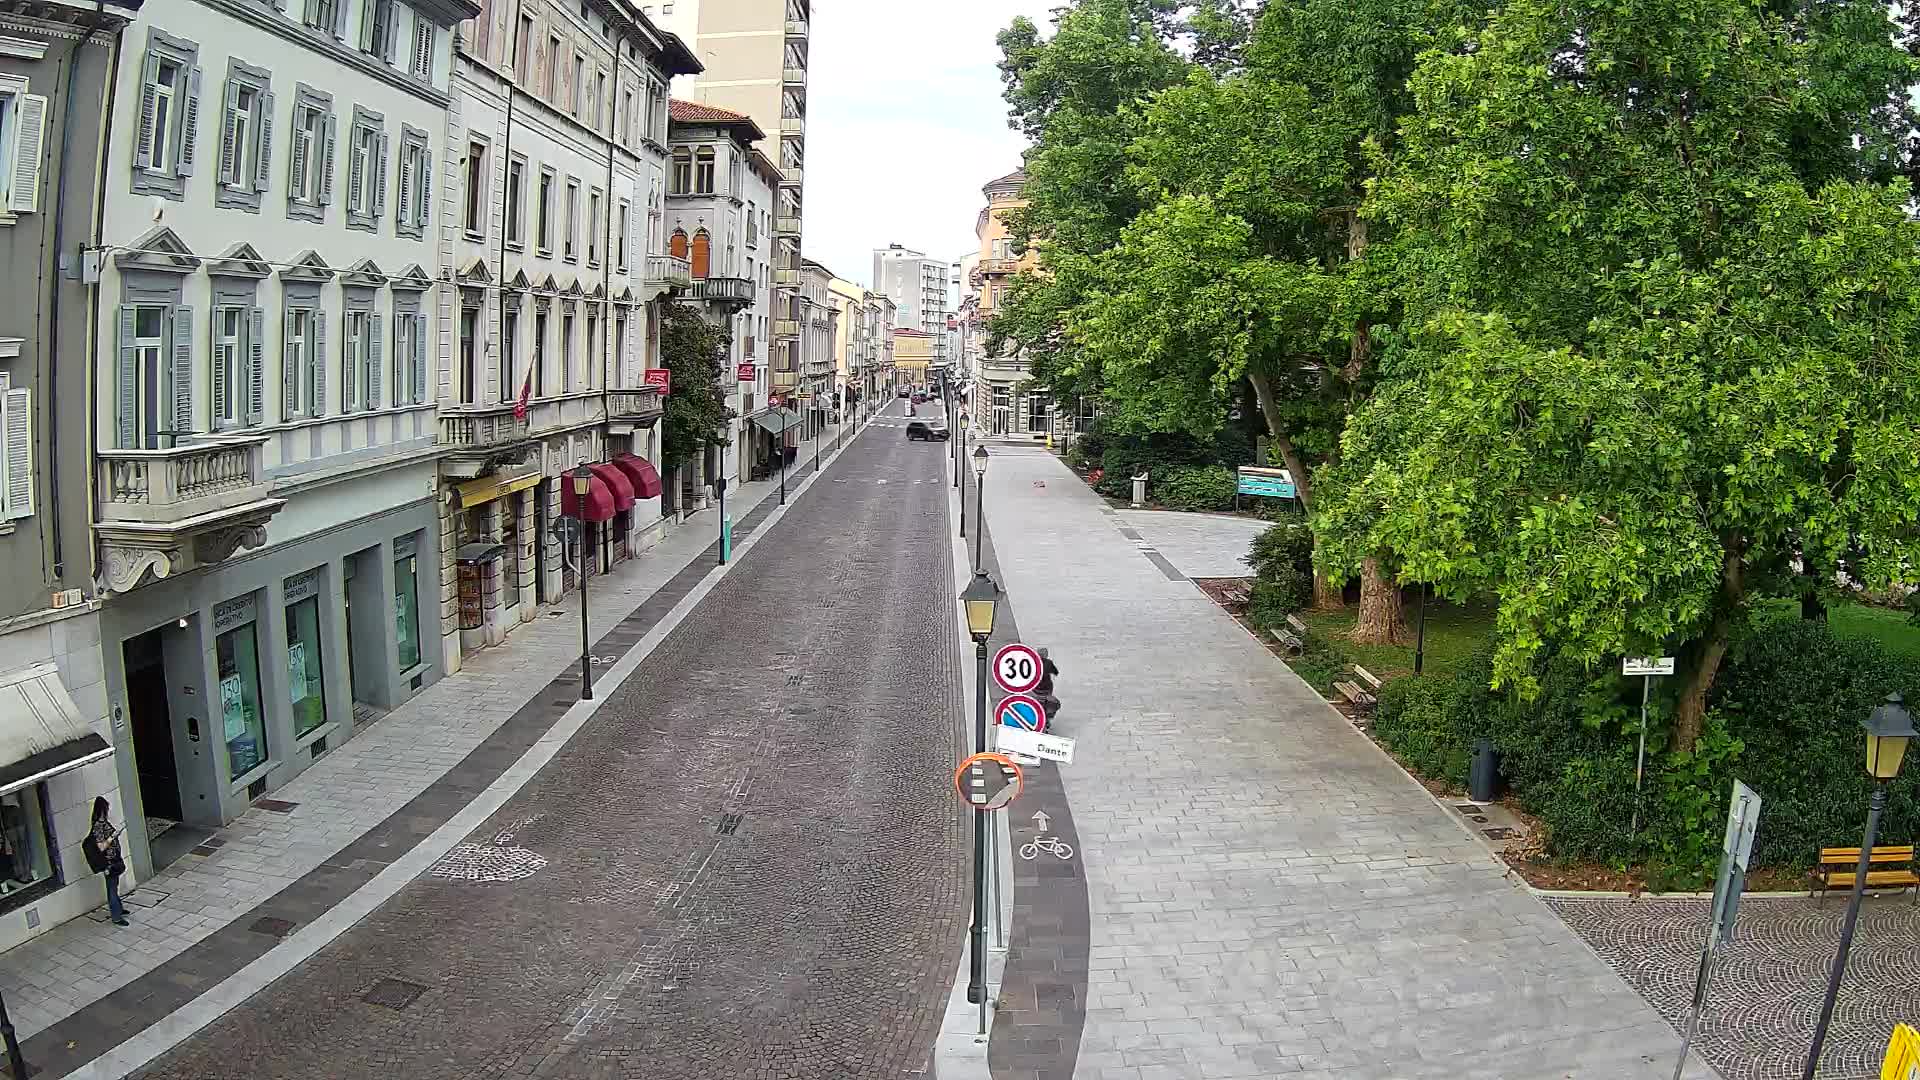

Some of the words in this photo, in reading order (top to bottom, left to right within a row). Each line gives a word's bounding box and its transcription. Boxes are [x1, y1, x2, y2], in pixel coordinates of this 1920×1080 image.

[1005, 658, 1032, 679] 30
[222, 678, 240, 702] 130
[1037, 744, 1067, 757] Dante
